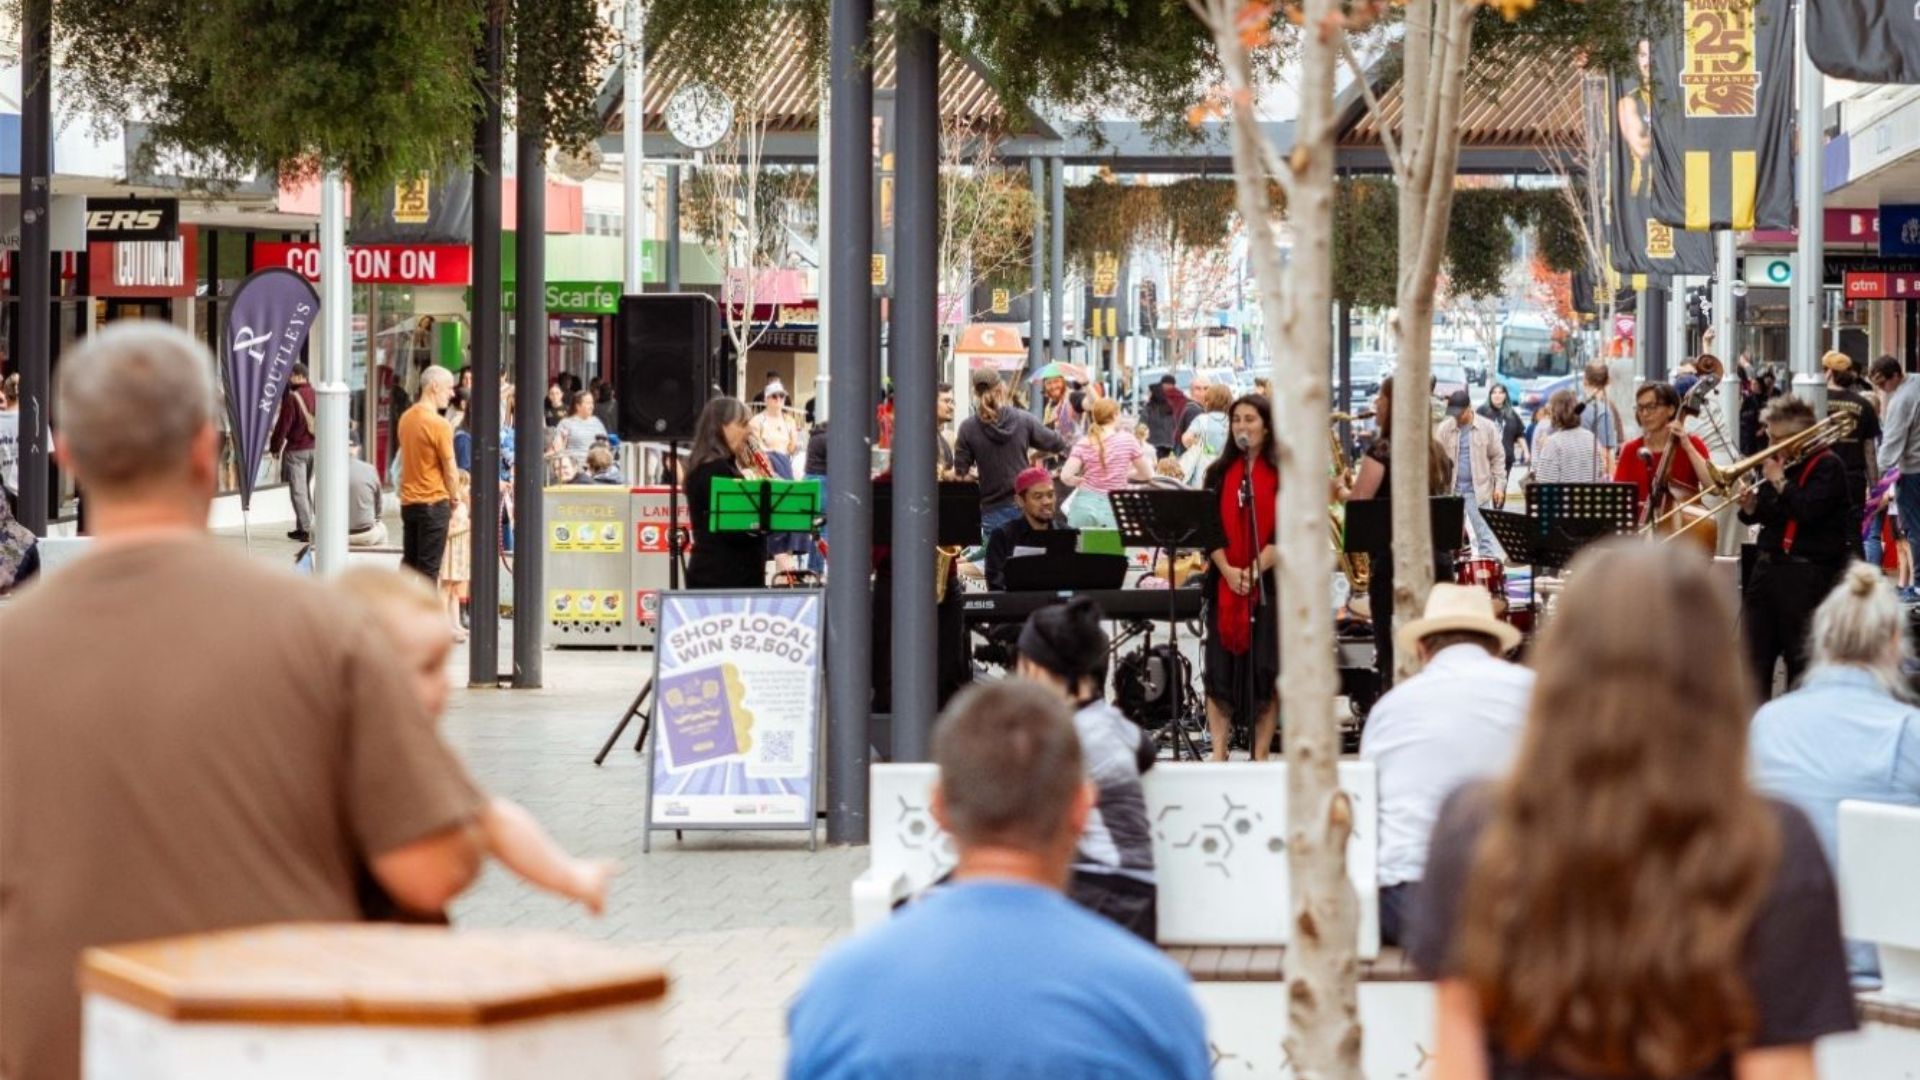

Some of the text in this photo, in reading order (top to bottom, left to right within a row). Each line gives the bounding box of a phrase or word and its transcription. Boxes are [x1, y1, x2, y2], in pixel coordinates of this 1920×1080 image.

[1692, 12, 1747, 72] 25
[86, 210, 163, 230] ERS
[287, 248, 436, 279] COTON ON
[546, 286, 614, 308] Scarfe
[1851, 280, 1878, 292] atm
[798, 333, 818, 346] RE
[258, 301, 312, 413] ROUTLEYS
[642, 505, 690, 517] LANFI
[670, 618, 811, 648] SHOP LOCAL
[676, 634, 803, 663] WIN $2,500
